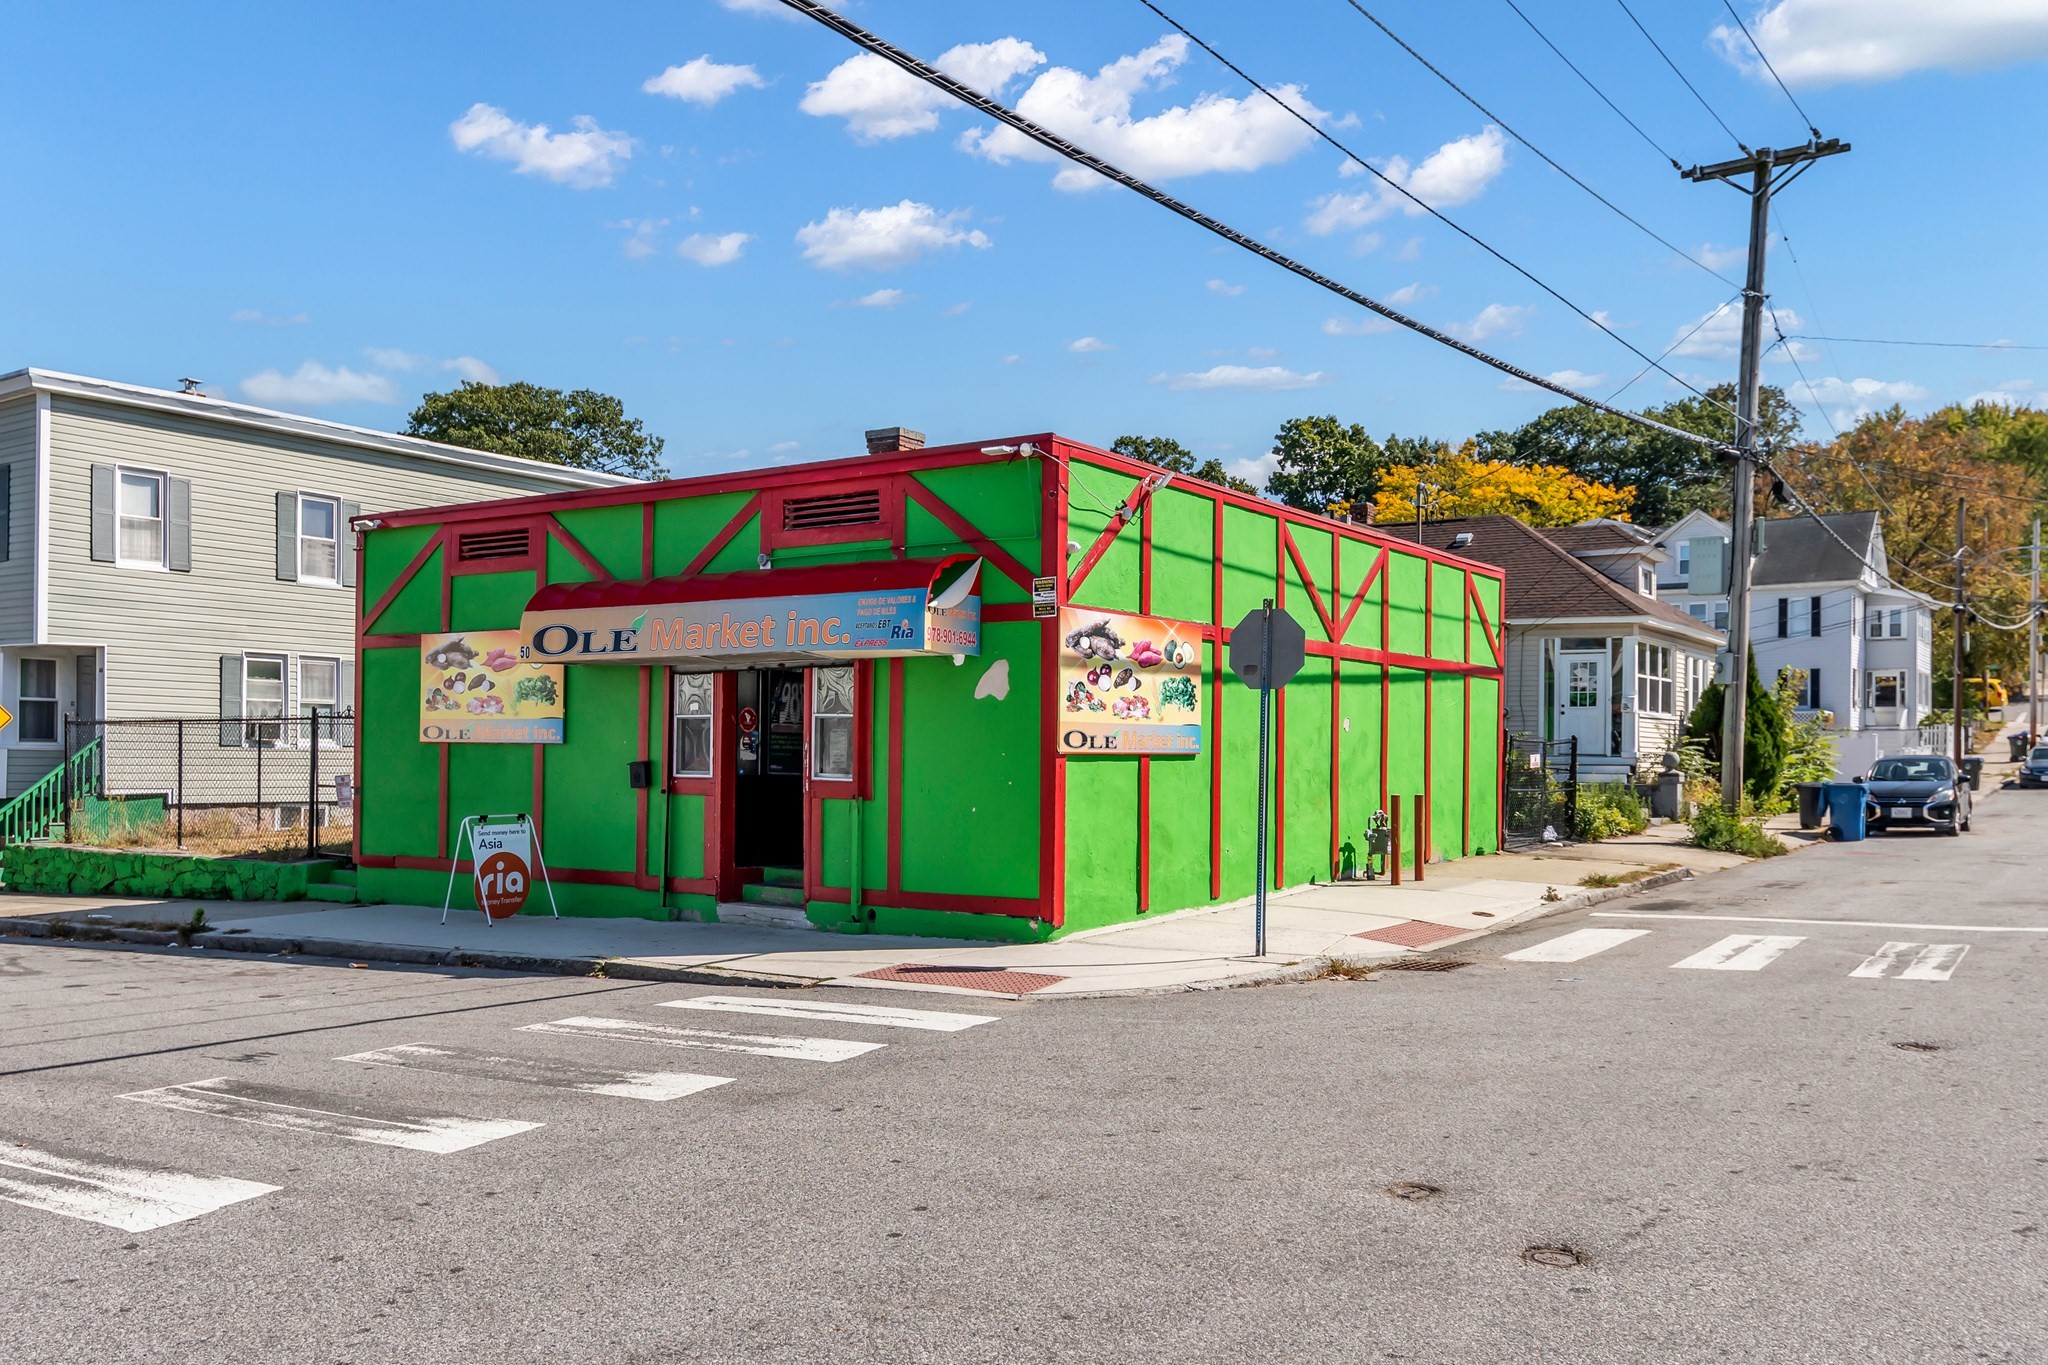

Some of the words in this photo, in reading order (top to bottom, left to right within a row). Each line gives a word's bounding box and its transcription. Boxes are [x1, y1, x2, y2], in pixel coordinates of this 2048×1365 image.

[878, 597, 886, 605] DE
[857, 608, 872, 617] PAGO
[873, 607, 881, 616] DE
[878, 619, 892, 629] EBT
[890, 618, 915, 640] Ria
[532, 624, 639, 657] OLE
[650, 612, 777, 652] Market
[786, 610, 850, 646] inc.
[520, 646, 530, 659] 50
[474, 724, 530, 740] Market
[532, 724, 560, 740] inc.
[1122, 730, 1174, 750] Market
[1176, 732, 1200, 750] inc.
[478, 838, 503, 850] Asia
[481, 861, 524, 896] ria
